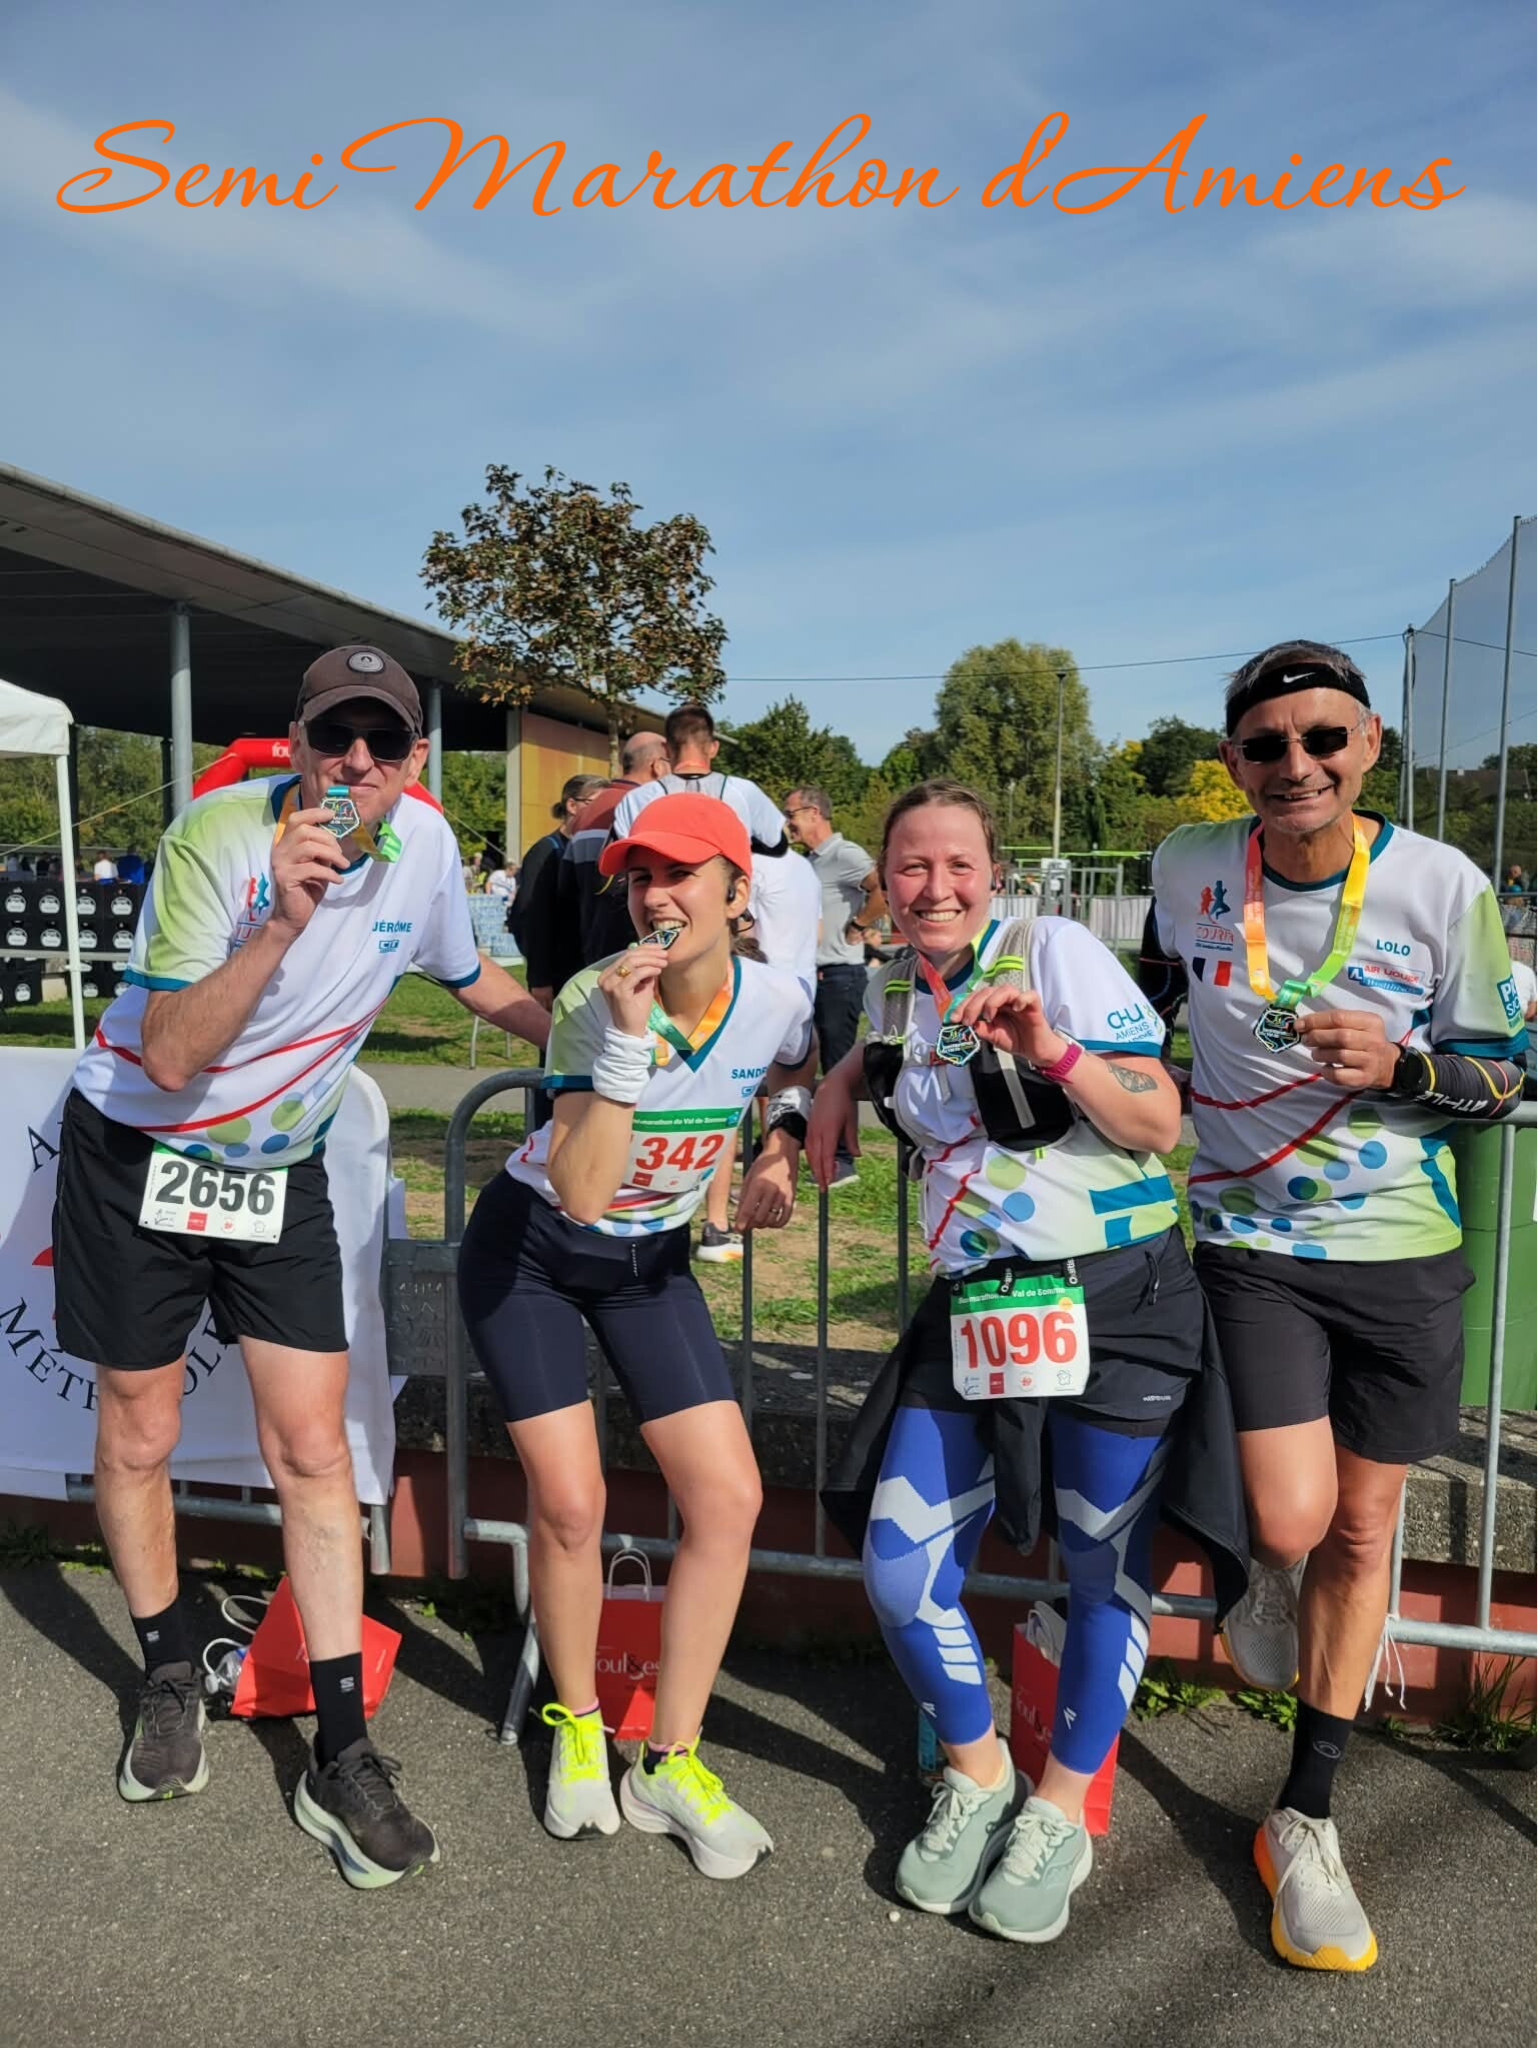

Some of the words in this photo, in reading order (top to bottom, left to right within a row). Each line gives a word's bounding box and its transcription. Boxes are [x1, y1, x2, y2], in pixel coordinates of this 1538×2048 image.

[1376, 939, 1411, 956] LOLO
[1364, 965, 1380, 973] AIR
[1107, 1003, 1145, 1029] CHU
[1116, 1021, 1150, 1041] AMIENS
[631, 1134, 725, 1171] 342
[155, 1161, 276, 1216] 2656
[961, 1311, 1078, 1369] 1096
